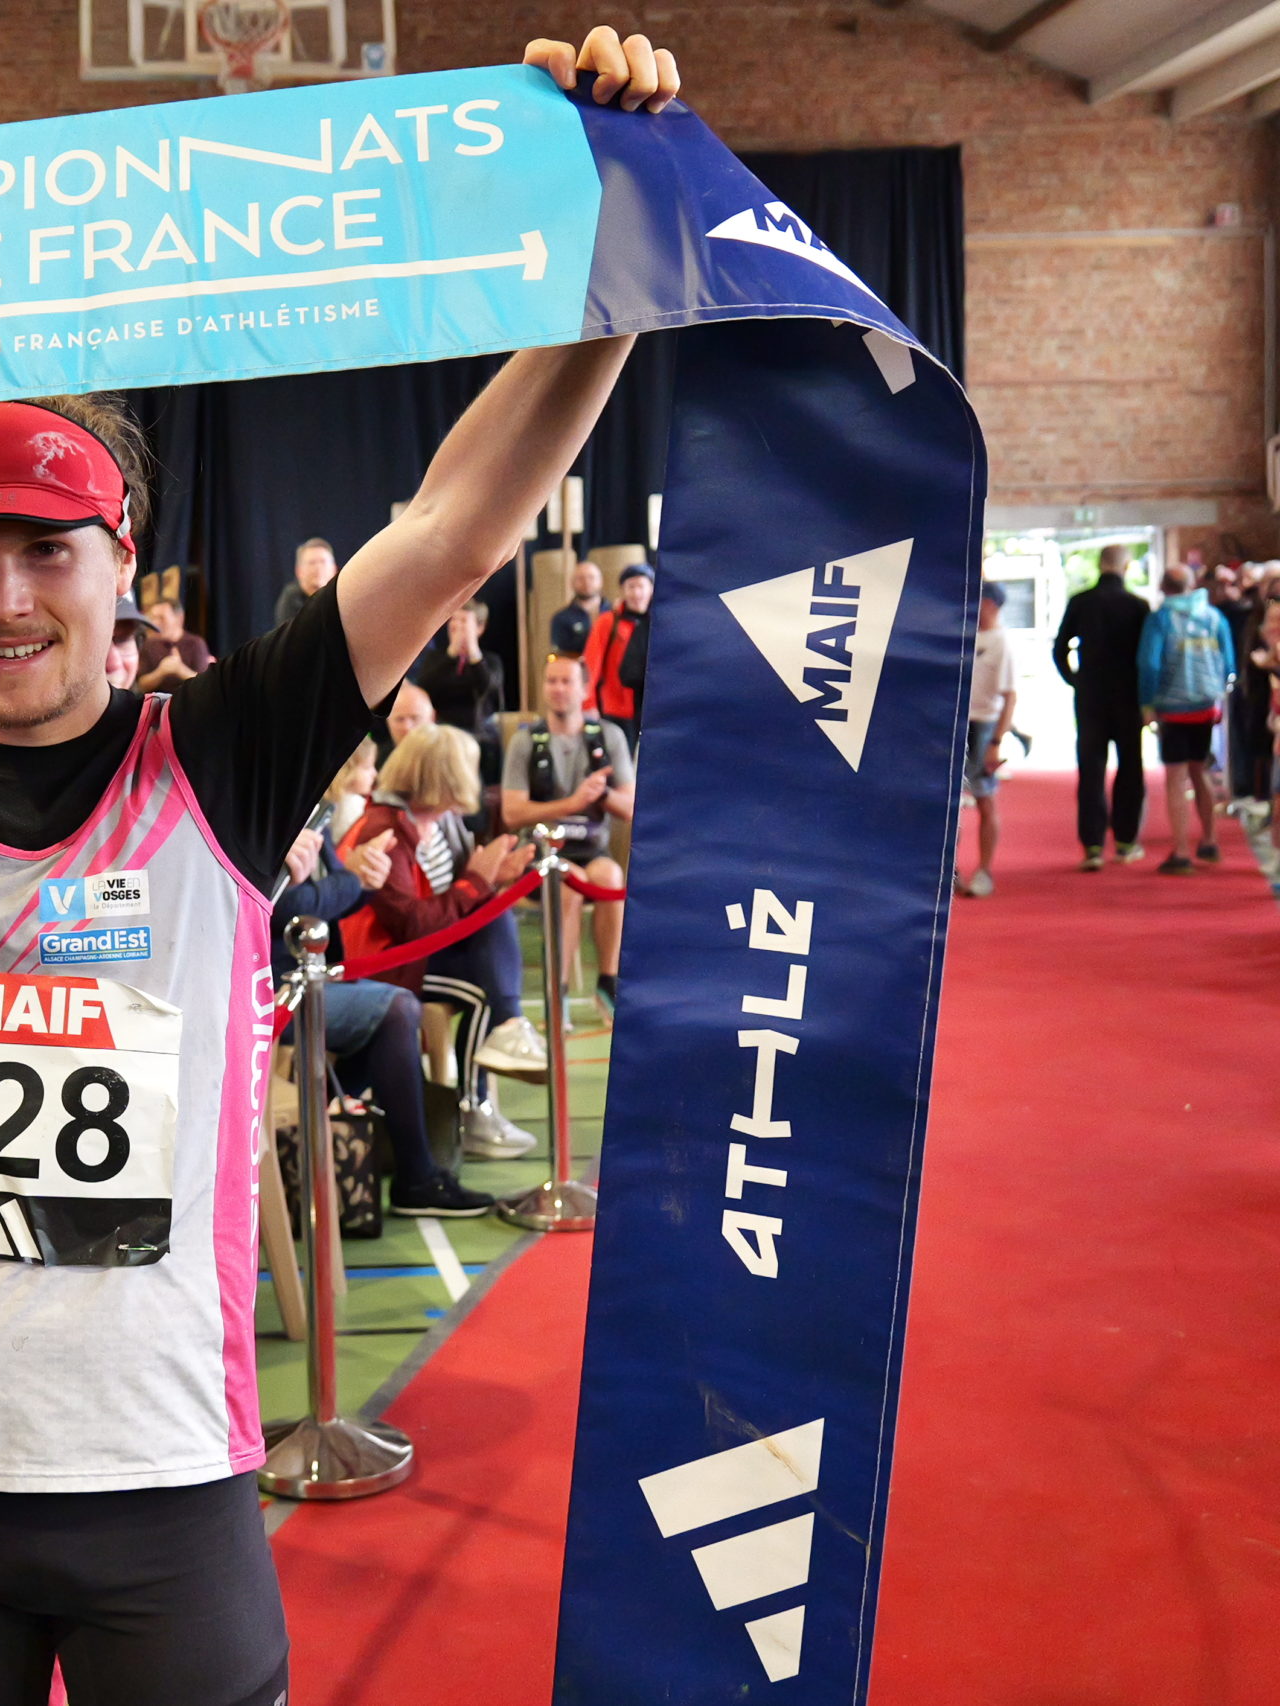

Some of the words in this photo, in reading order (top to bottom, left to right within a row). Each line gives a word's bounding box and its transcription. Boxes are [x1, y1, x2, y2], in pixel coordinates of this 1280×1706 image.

[29, 188, 383, 285] FRANCE
[14, 319, 164, 354] FRANÇAISE
[801, 561, 863, 723] MAIF
[93, 889, 141, 902] VOSGES
[106, 878, 126, 889] VIE
